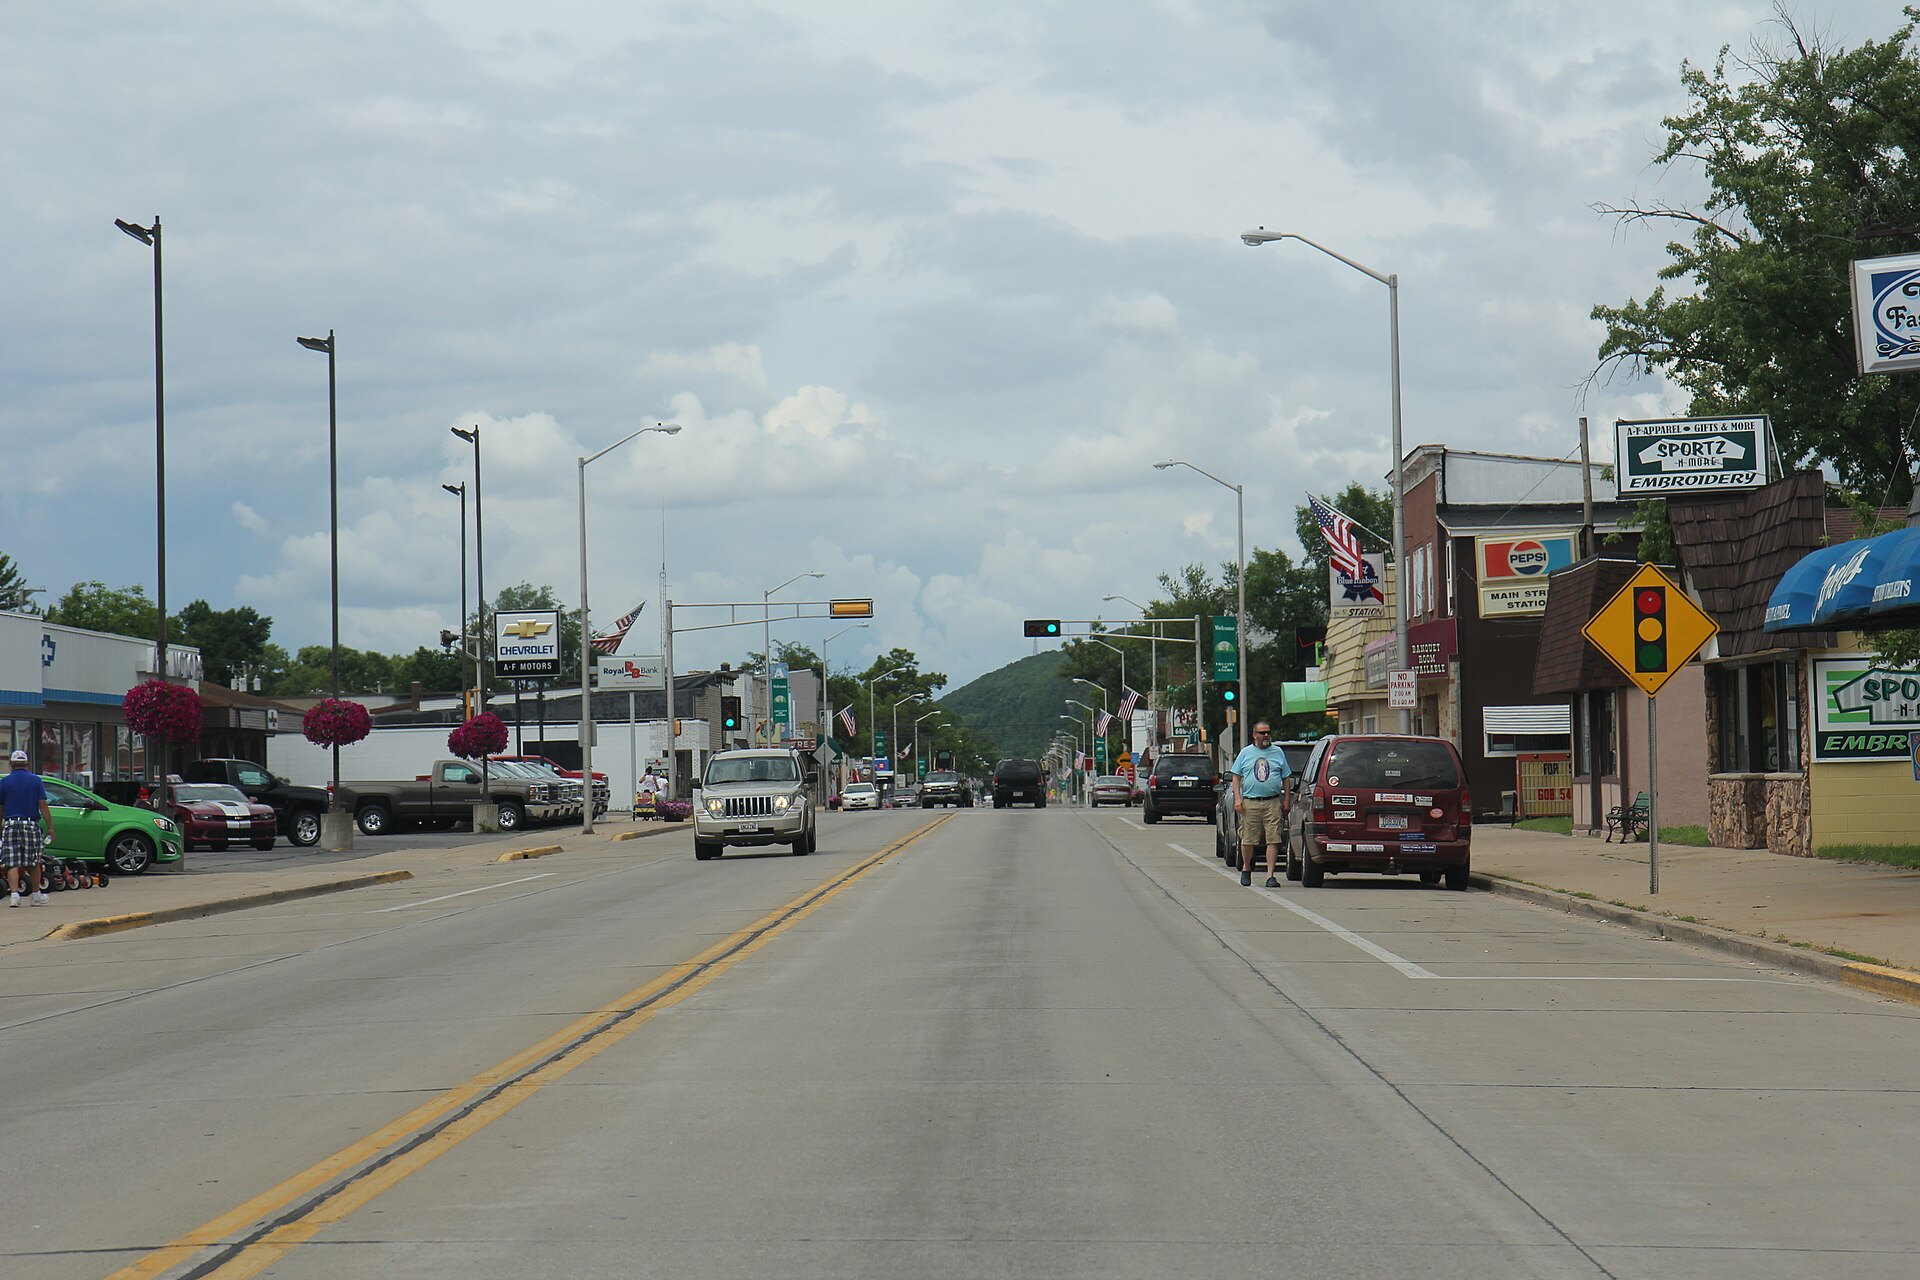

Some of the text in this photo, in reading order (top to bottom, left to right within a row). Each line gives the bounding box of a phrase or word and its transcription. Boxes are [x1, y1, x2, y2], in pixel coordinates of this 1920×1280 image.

[1886, 305, 1920, 329] Fa
[1643, 424, 1682, 435] APPAREL
[1694, 423, 1718, 432] GIFTS
[1721, 423, 1728, 431] &
[1731, 421, 1755, 430] MORE
[1657, 441, 1727, 457] SPORTZ
[1629, 472, 1757, 489] EMBROIDERY
[1509, 552, 1547, 563] PEPSI
[1338, 576, 1353, 584] Blue
[1490, 591, 1519, 600] MAIN
[1349, 608, 1384, 617] STATION
[500, 645, 554, 655] CHEVROLET
[1411, 643, 1440, 654] BANQUET
[1418, 654, 1436, 664] ROOM
[520, 662, 552, 670] MOTORS
[603, 667, 624, 676] Royal
[1397, 673, 1407, 681] NO
[1390, 681, 1415, 689] PARKING
[1823, 735, 1910, 752] EMBR
[1543, 763, 1560, 775] FOR
